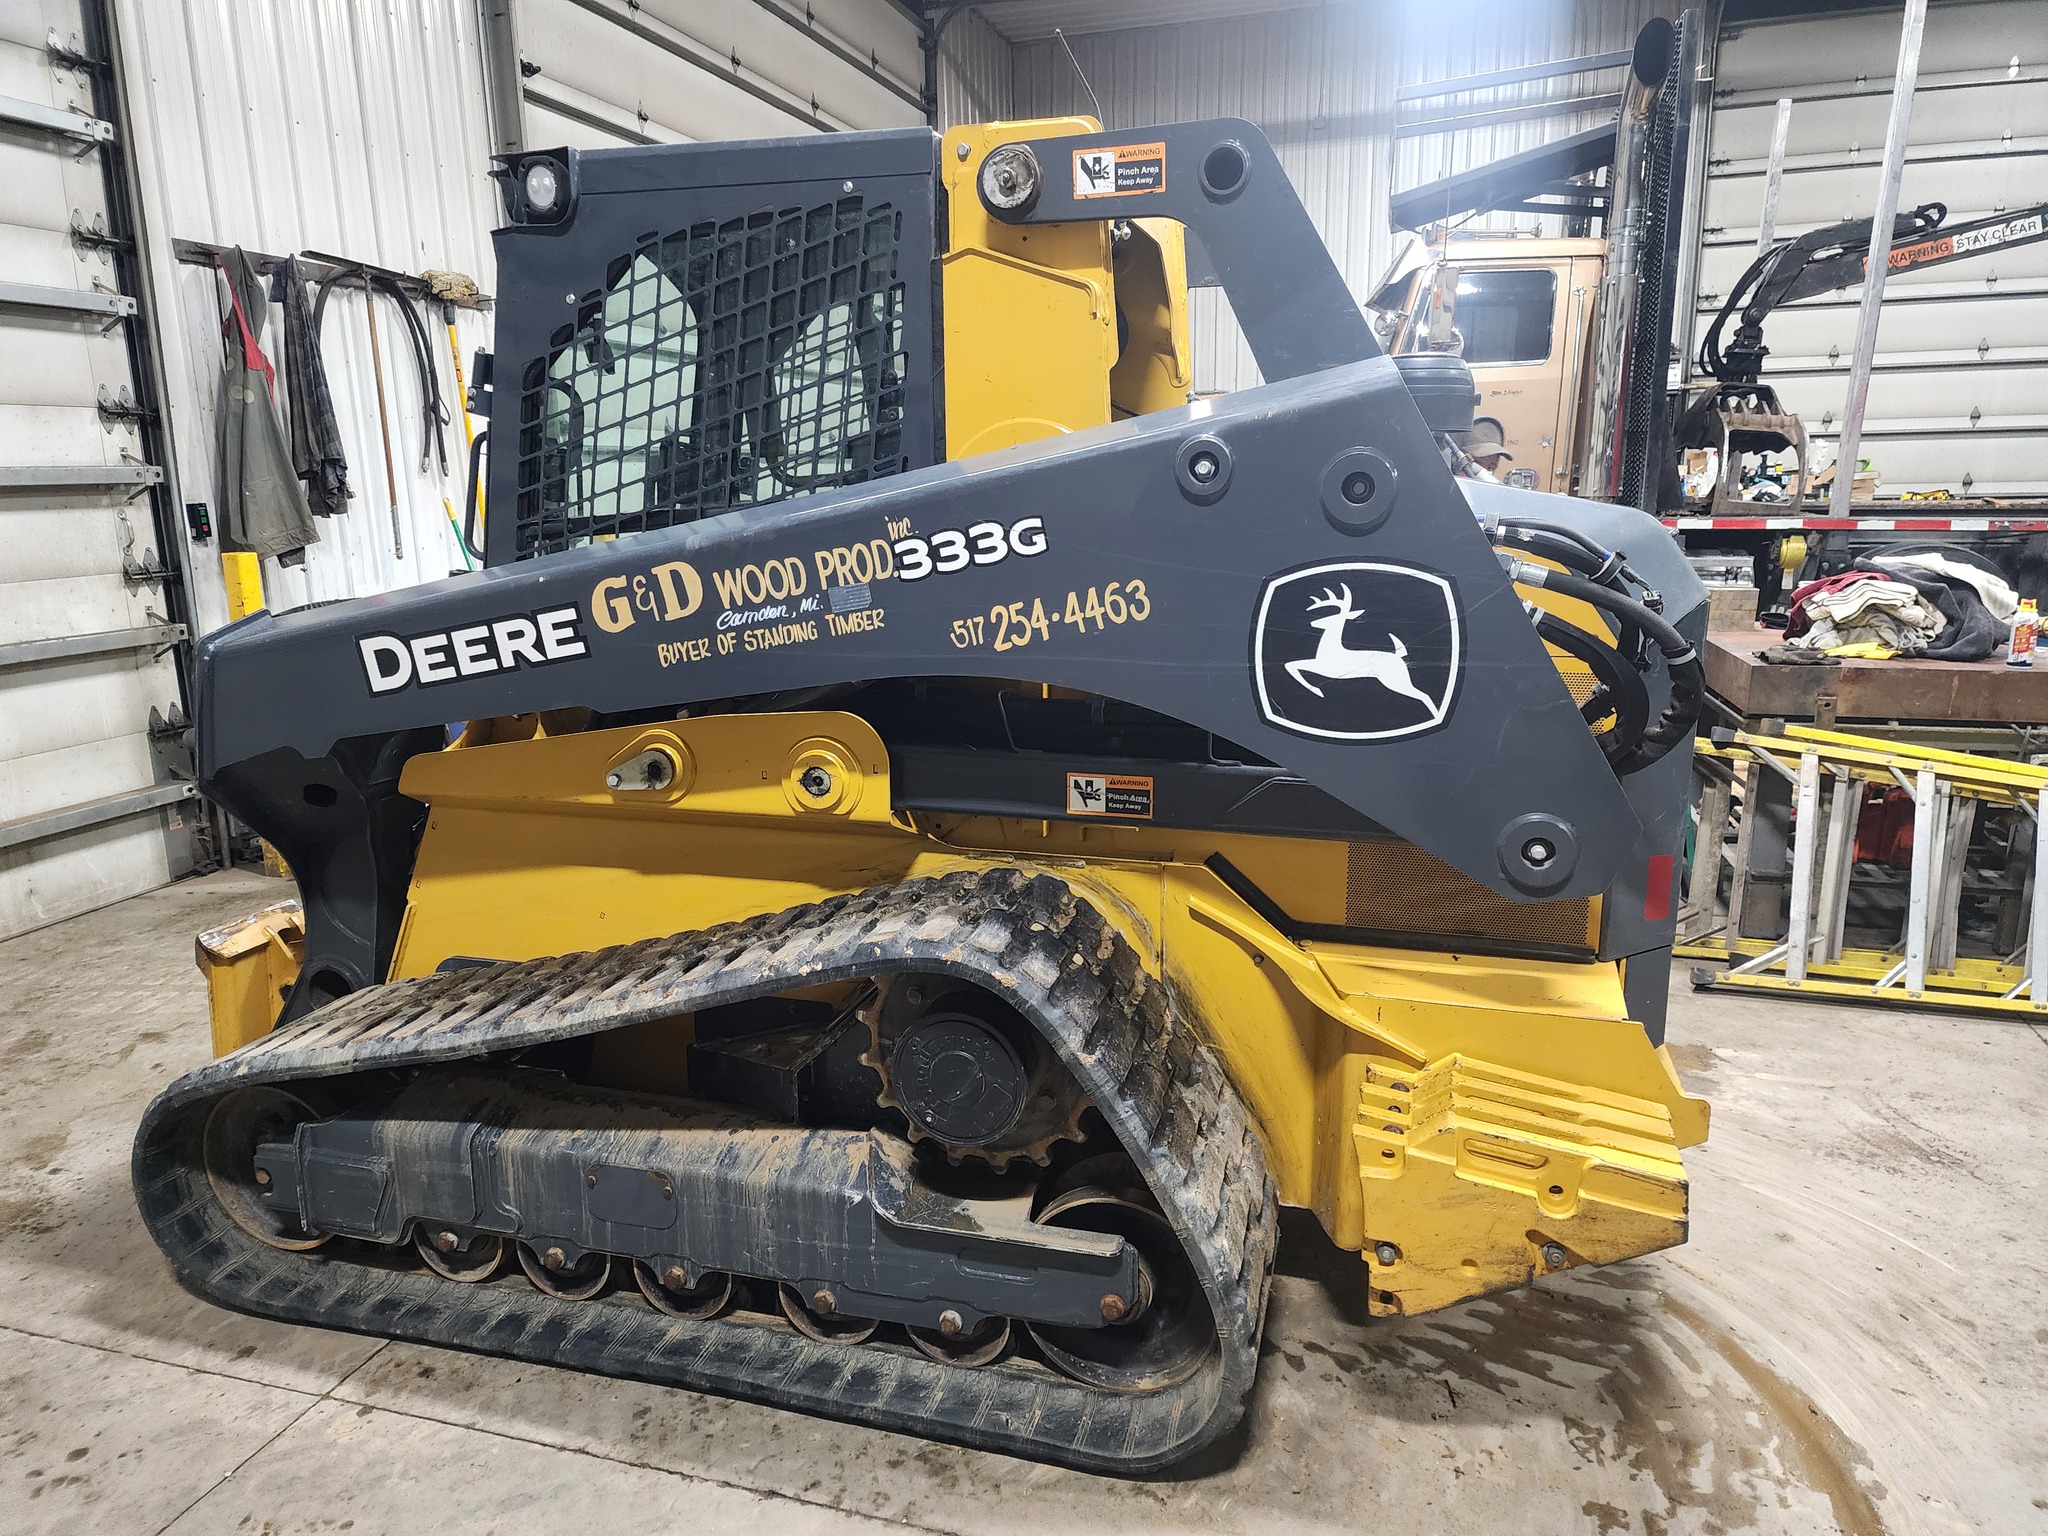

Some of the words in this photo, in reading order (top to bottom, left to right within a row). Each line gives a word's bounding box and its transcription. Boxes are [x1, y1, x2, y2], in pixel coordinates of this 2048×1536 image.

[1126, 148, 1161, 157] WARNING
[1117, 167, 1139, 176] Pinch
[1141, 165, 1160, 174] Area
[1117, 178, 1134, 186] Keep
[1135, 176, 1154, 184] Away
[1888, 242, 1949, 264] WARNING
[1956, 232, 1989, 249] STAY
[1992, 220, 2038, 240] CLEAR
[893, 517, 1048, 581] 333G
[591, 561, 704, 633] G&D
[712, 557, 807, 611] WOOD
[814, 538, 899, 590] PROD.
[657, 637, 712, 668] BUYER
[716, 631, 738, 655] OF
[743, 620, 818, 652] STANDING
[824, 608, 885, 637] TIMBER
[950, 616, 984, 649] 517
[358, 606, 587, 694] DEERE
[1108, 793, 1129, 801] Pinch
[1129, 794, 1148, 802] Area
[1116, 779, 1149, 787] WARNING
